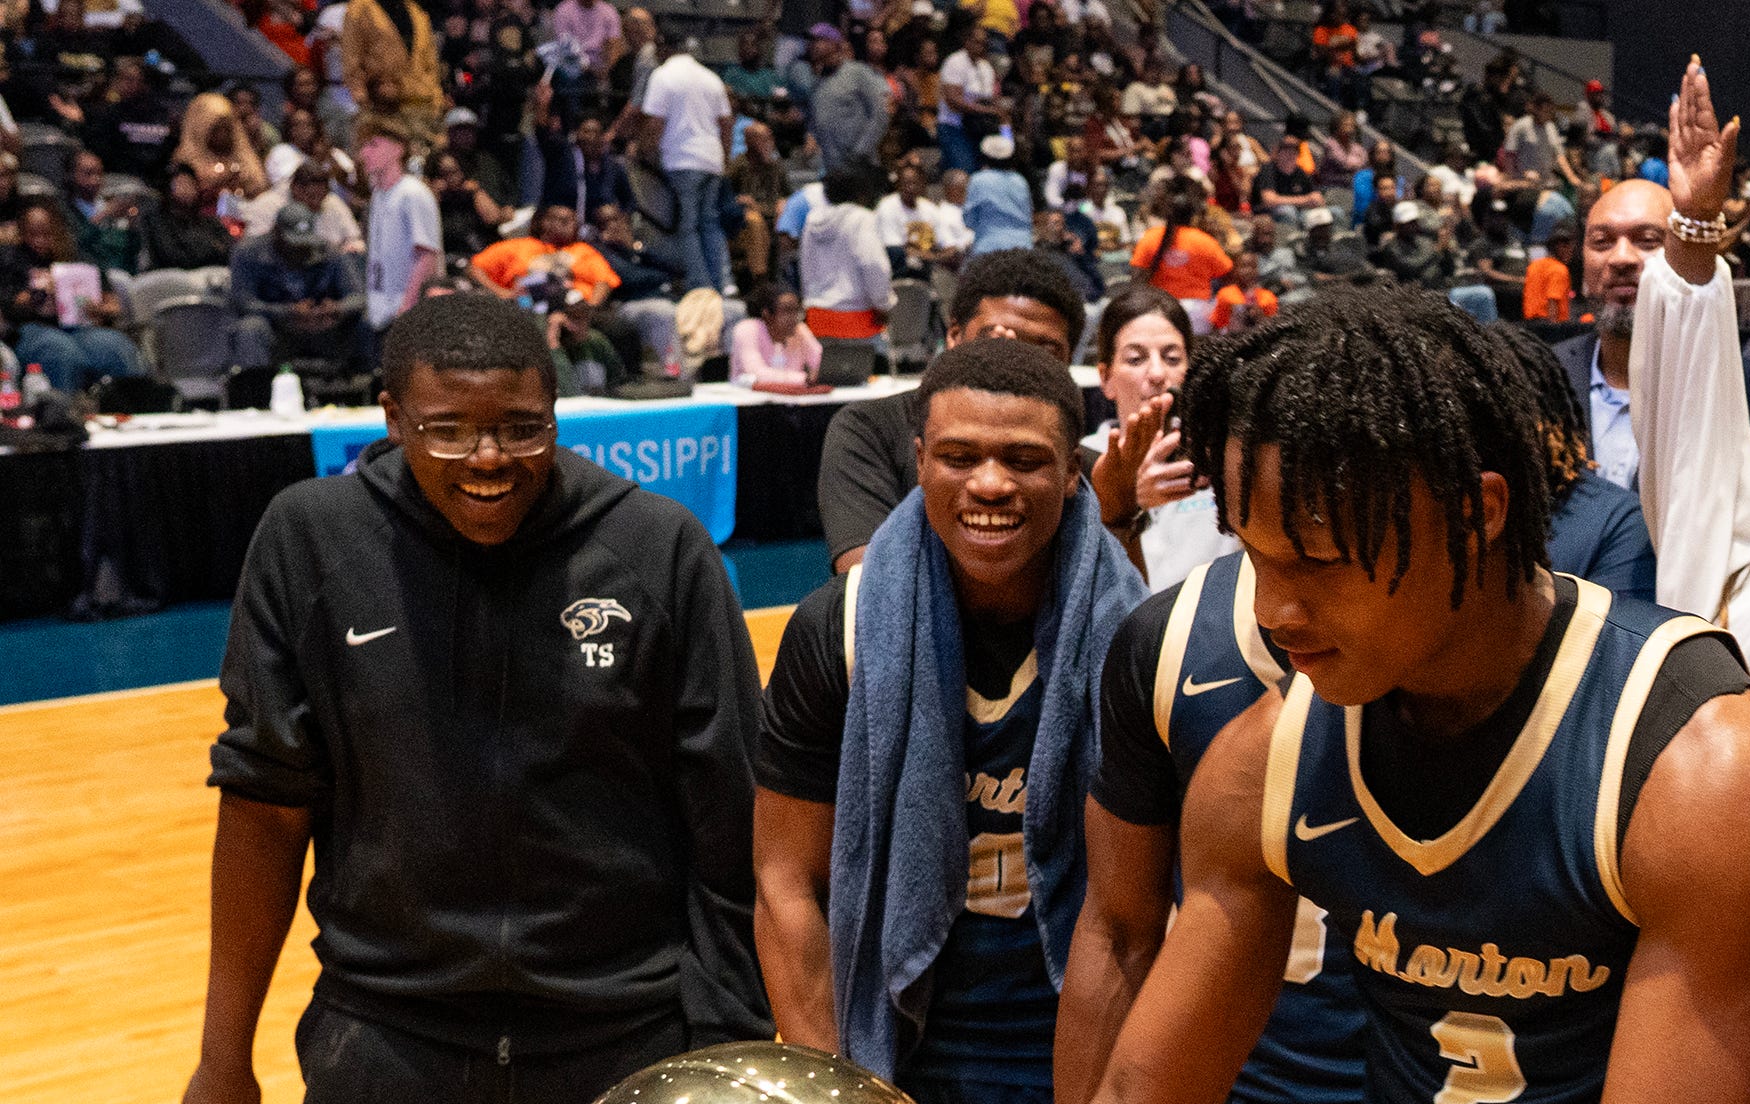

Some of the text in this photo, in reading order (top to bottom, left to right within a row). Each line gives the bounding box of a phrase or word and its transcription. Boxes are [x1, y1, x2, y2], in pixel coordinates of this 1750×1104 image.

[571, 434, 732, 484] ISSIPPI
[580, 642, 615, 668] TS
[1353, 908, 1611, 999] Morton
